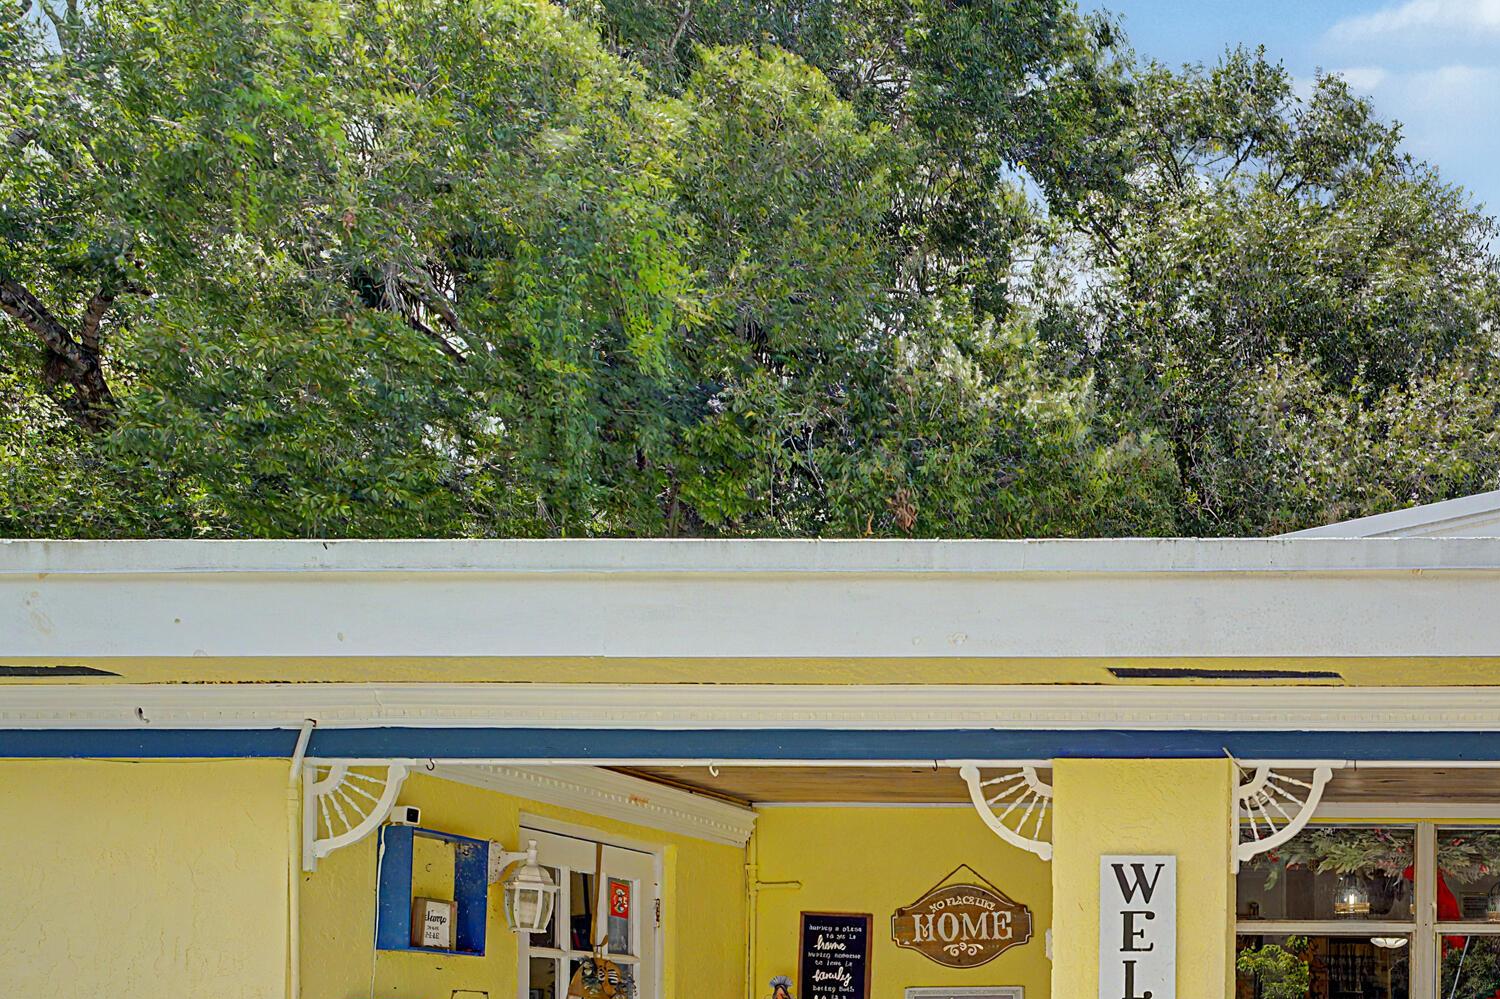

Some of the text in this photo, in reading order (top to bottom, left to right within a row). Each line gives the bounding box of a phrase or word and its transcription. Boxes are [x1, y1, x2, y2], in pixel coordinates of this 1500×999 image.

[929, 901, 946, 913] NO
[911, 910, 1013, 943] HOME
[813, 934, 847, 951] home
[812, 966, 853, 987] family
